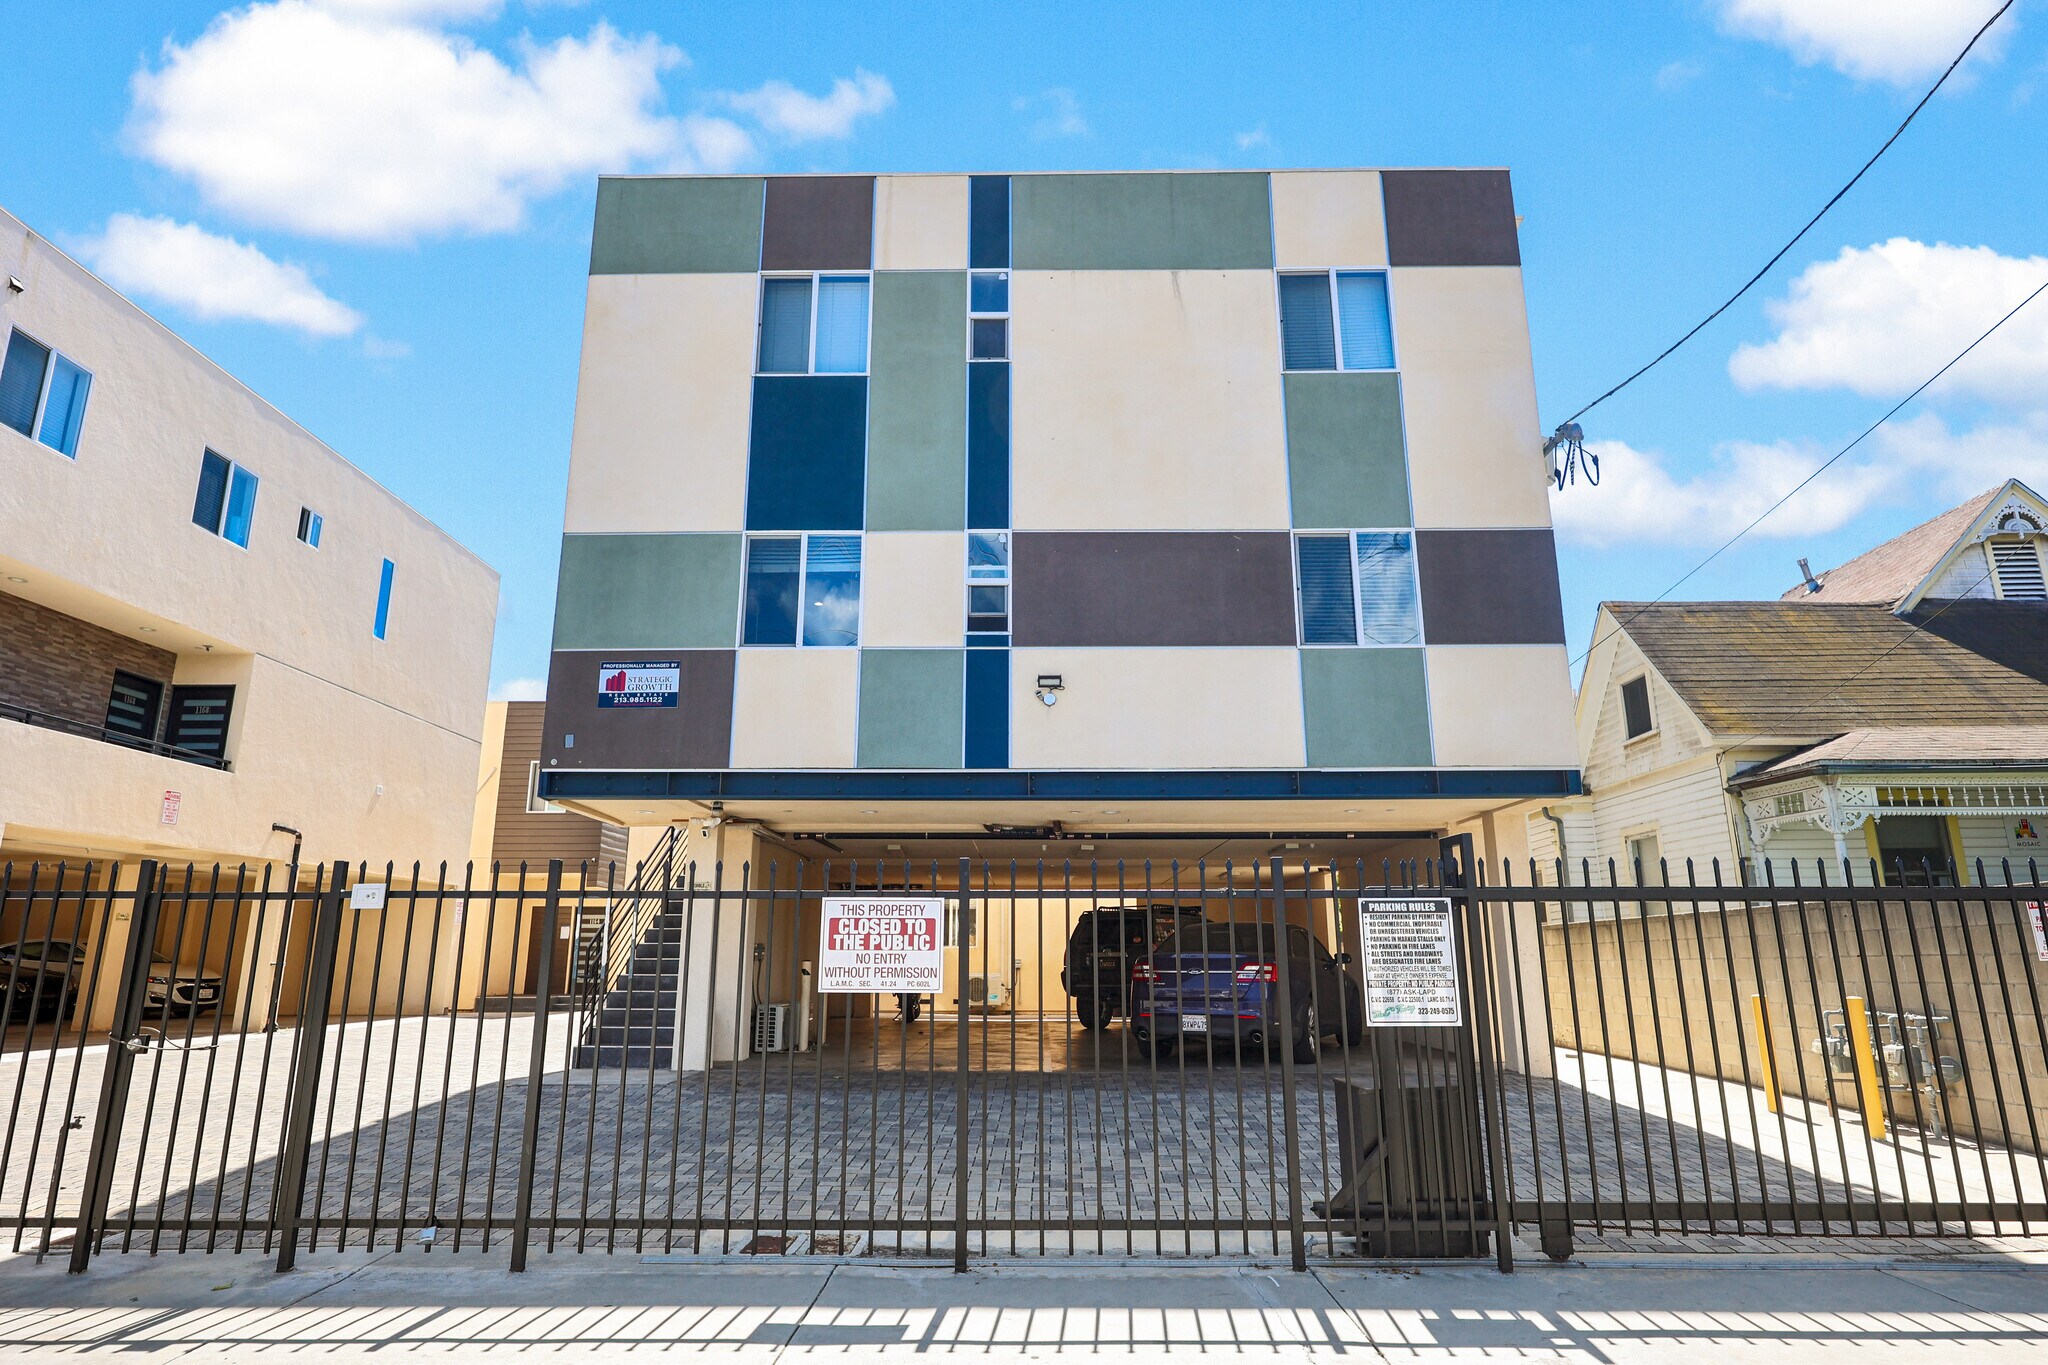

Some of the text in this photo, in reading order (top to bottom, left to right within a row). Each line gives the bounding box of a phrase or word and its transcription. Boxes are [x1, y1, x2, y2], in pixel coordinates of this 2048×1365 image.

[840, 904, 926, 916] THIS PROPERTY
[1368, 902, 1436, 912] PARKING RULES
[838, 918, 926, 934] CLOSED TO
[833, 934, 930, 950] THE PUBLIC
[855, 953, 907, 964] NO ENTRY
[824, 967, 938, 978] WITHOUT PERMISSION
